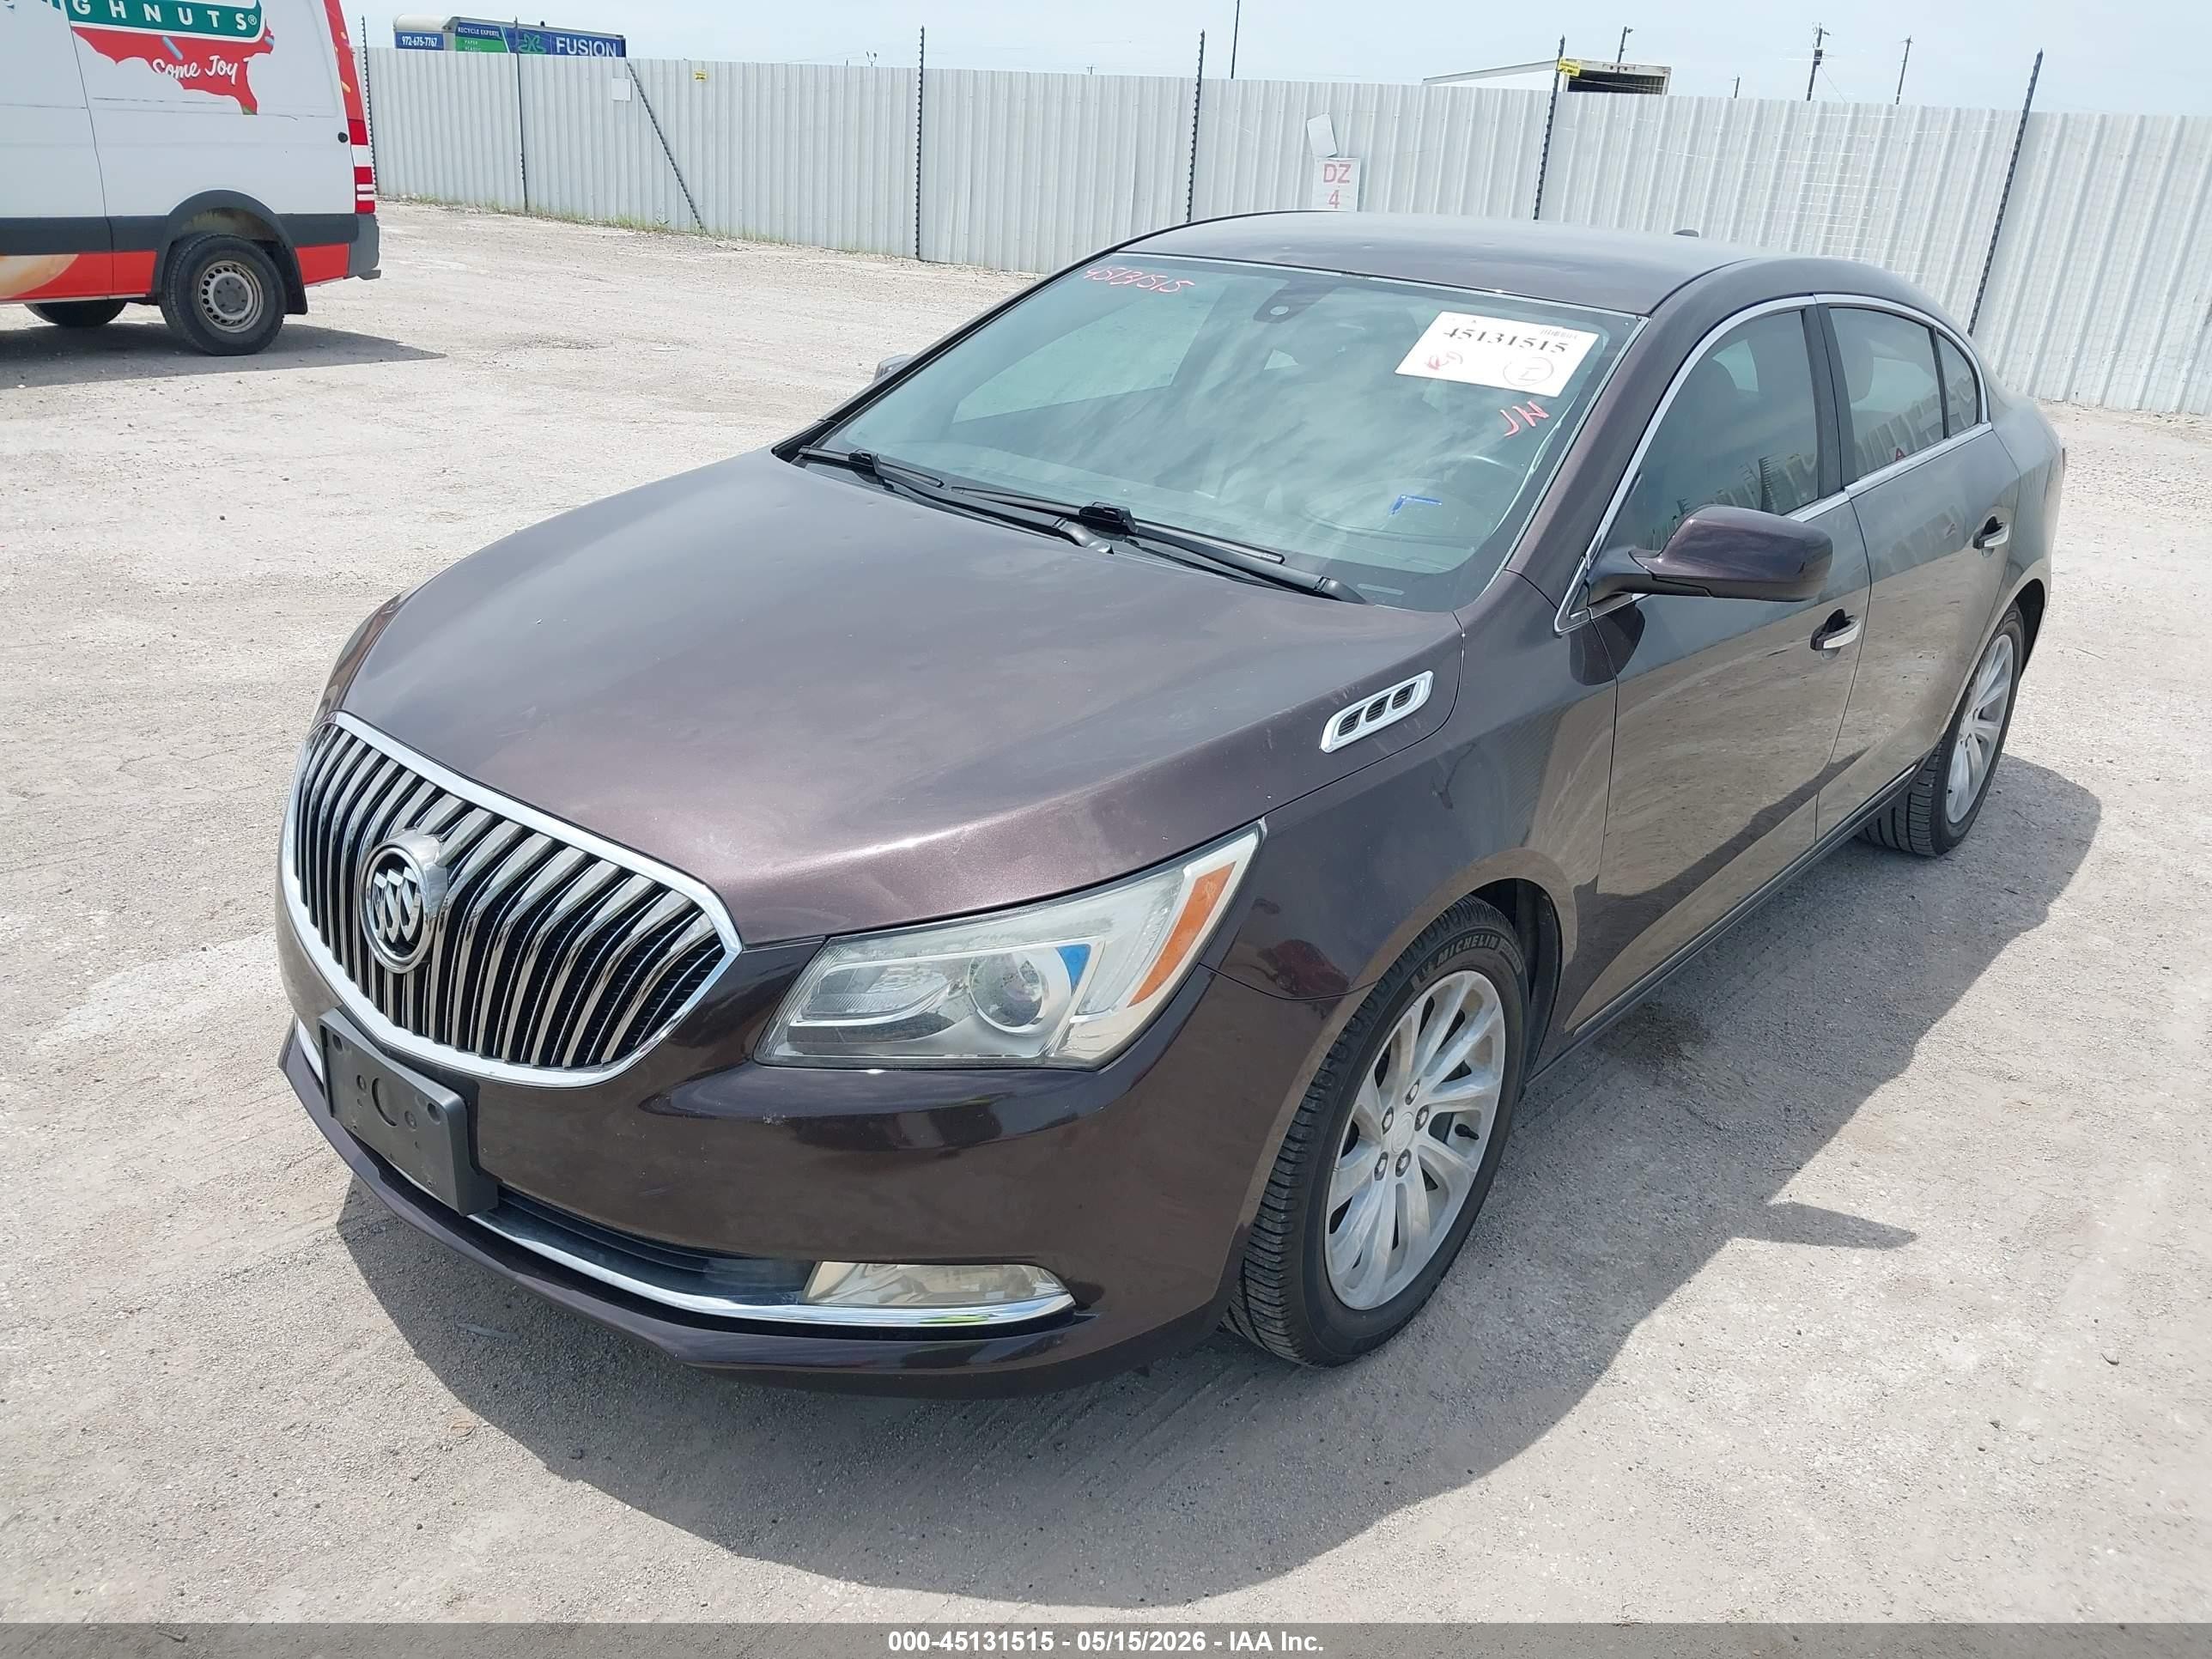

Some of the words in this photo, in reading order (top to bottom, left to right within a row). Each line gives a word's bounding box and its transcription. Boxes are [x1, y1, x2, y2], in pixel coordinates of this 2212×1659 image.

[401, 35, 438, 47] 972-675-7767
[556, 36, 617, 57] FUSION
[205, 55, 238, 85] Joy
[1323, 163, 1352, 184] DZ
[1328, 189, 1340, 209] 4
[1443, 326, 1570, 354] 45131515
[1437, 934, 1500, 966] MICHELIN
